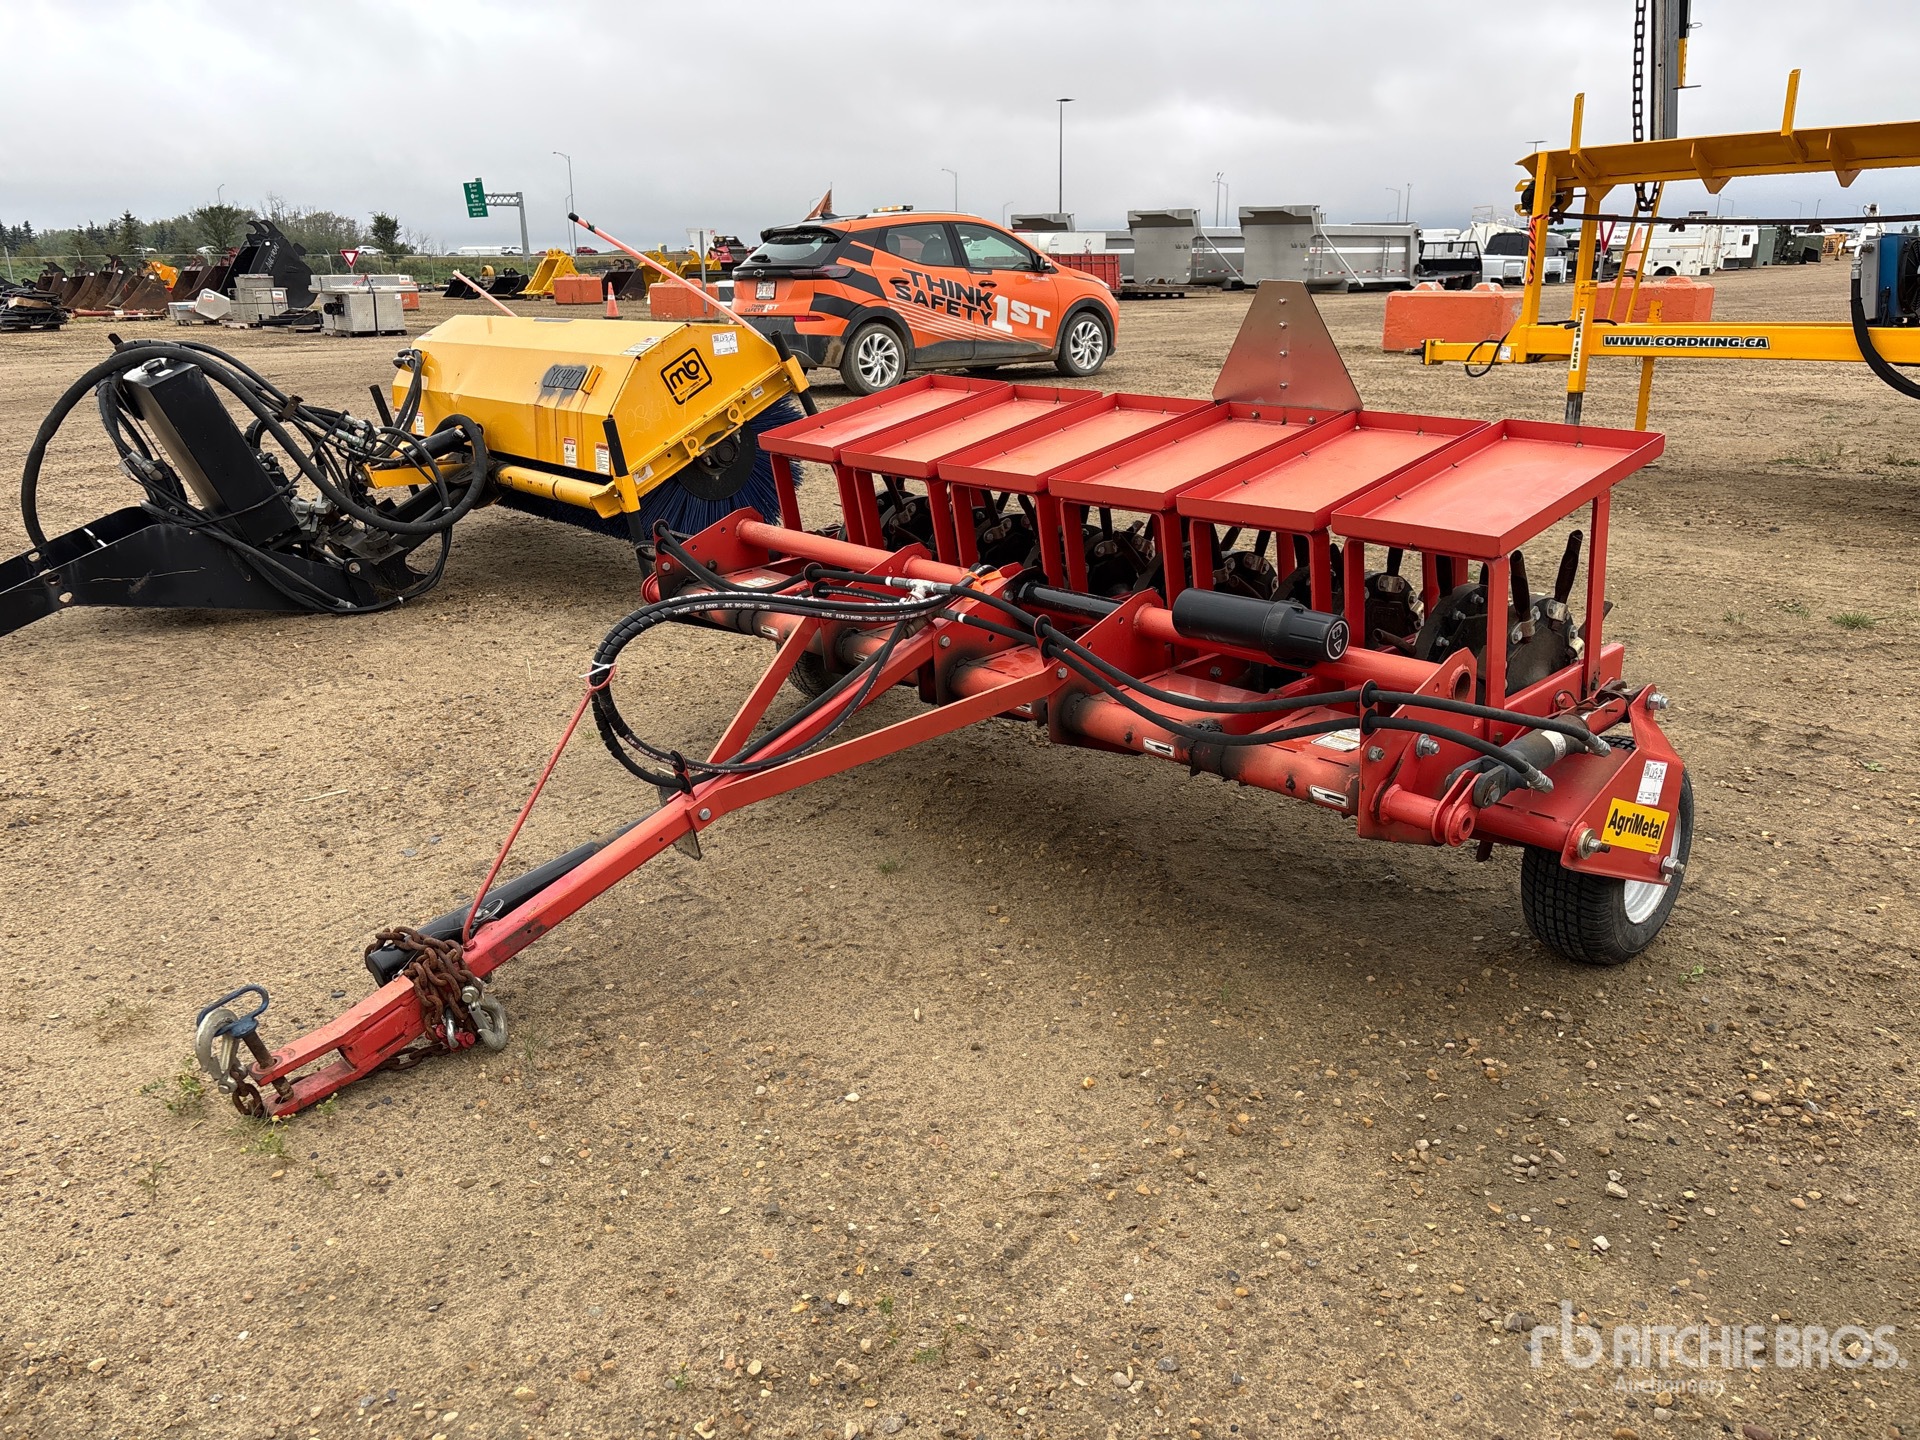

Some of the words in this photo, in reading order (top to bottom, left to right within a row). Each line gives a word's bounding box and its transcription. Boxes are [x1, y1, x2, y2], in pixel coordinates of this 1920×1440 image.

[895, 283, 994, 326] SAFETY
[902, 267, 994, 308] THINK
[991, 294, 1051, 333] 1ST
[1603, 334, 1769, 350] WWW.CORDKING.CA
[1608, 808, 1665, 840] AgriMetal
